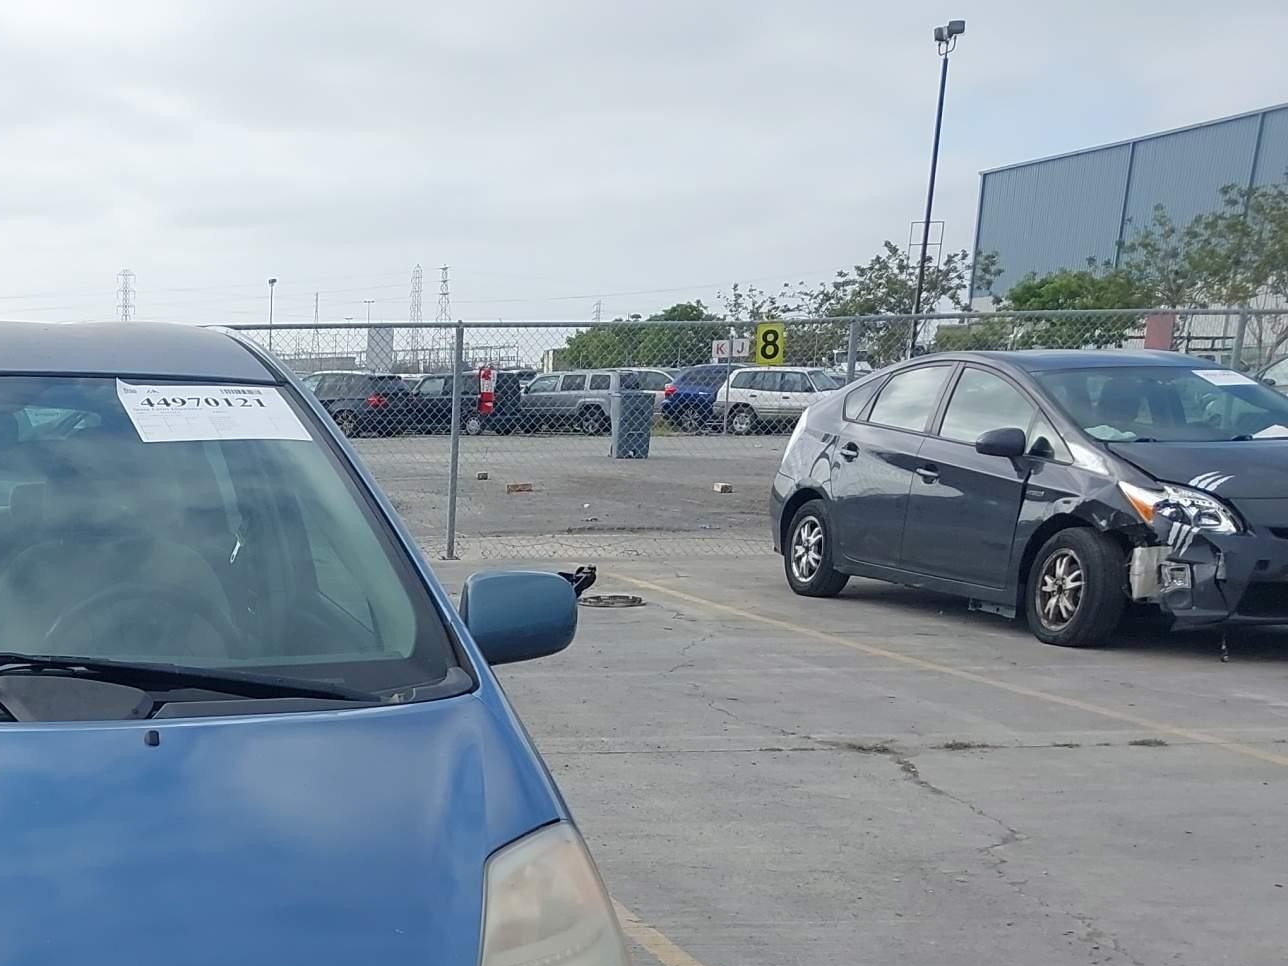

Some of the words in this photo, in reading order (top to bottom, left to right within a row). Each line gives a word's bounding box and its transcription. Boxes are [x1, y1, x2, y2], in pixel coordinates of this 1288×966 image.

[716, 343, 726, 355] K
[736, 342, 745, 354] J
[760, 329, 780, 360] 8
[140, 397, 267, 408] 44970121
